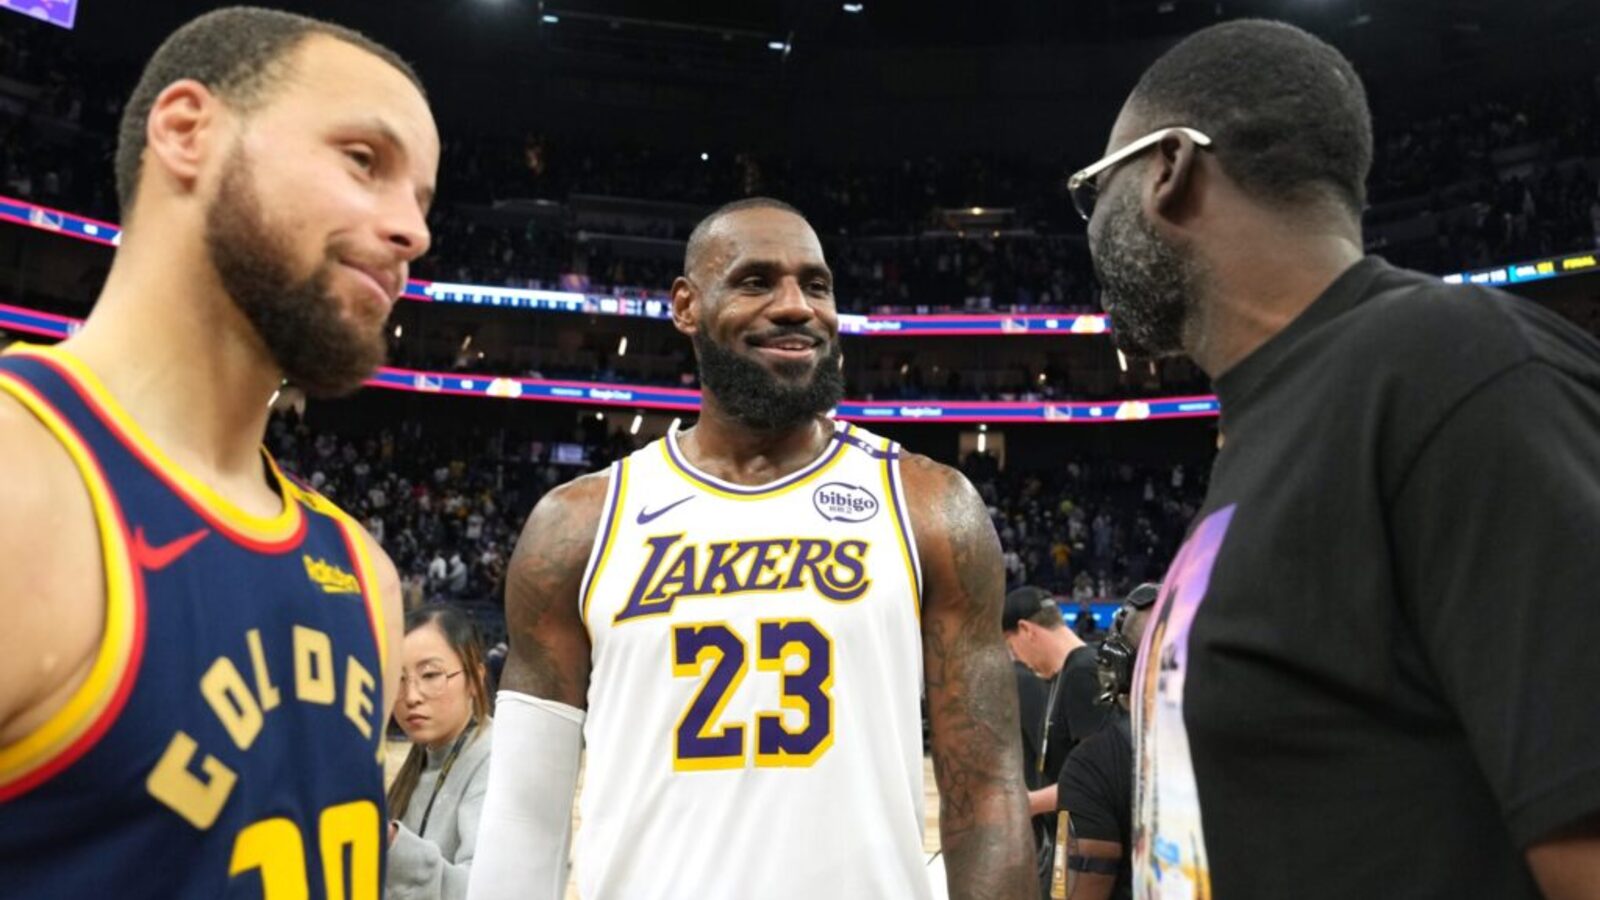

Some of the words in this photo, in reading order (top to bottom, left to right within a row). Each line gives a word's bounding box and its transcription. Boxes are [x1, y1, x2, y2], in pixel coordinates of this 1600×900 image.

[819, 491, 875, 512] bibigo
[612, 529, 872, 626] LAKERS
[146, 624, 388, 831] GOLDE
[670, 617, 835, 772] 23
